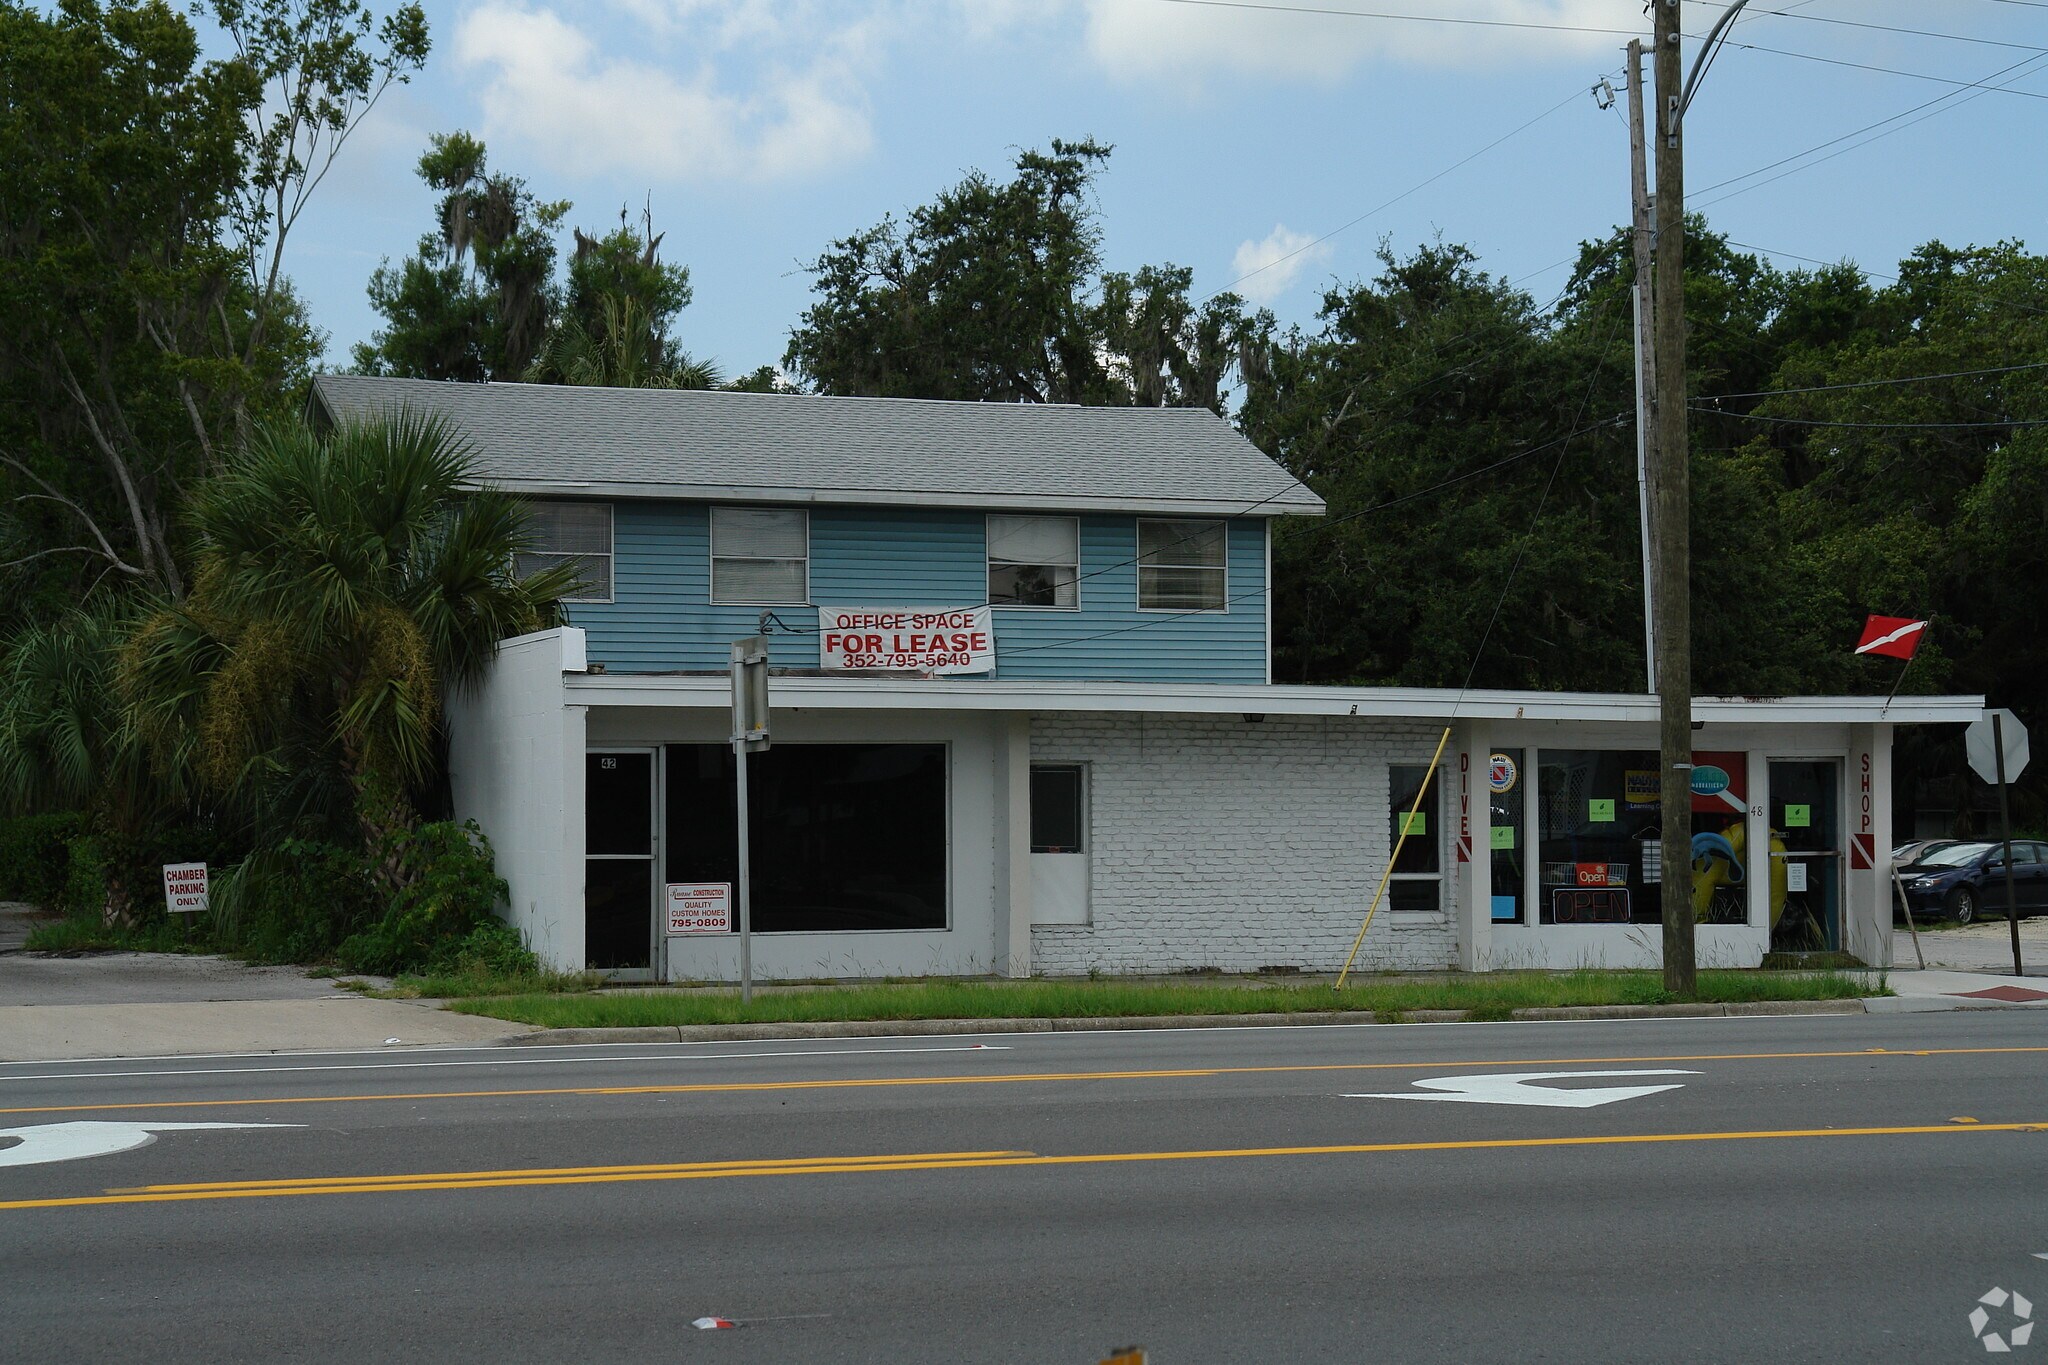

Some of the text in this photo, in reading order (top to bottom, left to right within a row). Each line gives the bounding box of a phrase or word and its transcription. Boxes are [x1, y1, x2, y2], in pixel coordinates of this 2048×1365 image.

[836, 614, 975, 629] OFFICE SPACE
[826, 633, 987, 653] FOR LEASE
[843, 653, 971, 668] 352-795-5640
[602, 759, 615, 768] 42
[1460, 753, 1469, 835] DIVE
[1861, 753, 1870, 832] SHOP
[1751, 805, 1763, 817] 48
[166, 869, 205, 881] CHAMBER
[1579, 870, 1605, 883] Open
[169, 883, 204, 895] PARKING
[176, 897, 199, 906] ONLY
[1556, 892, 1627, 921] OPEN
[671, 918, 726, 927] 795-0809
